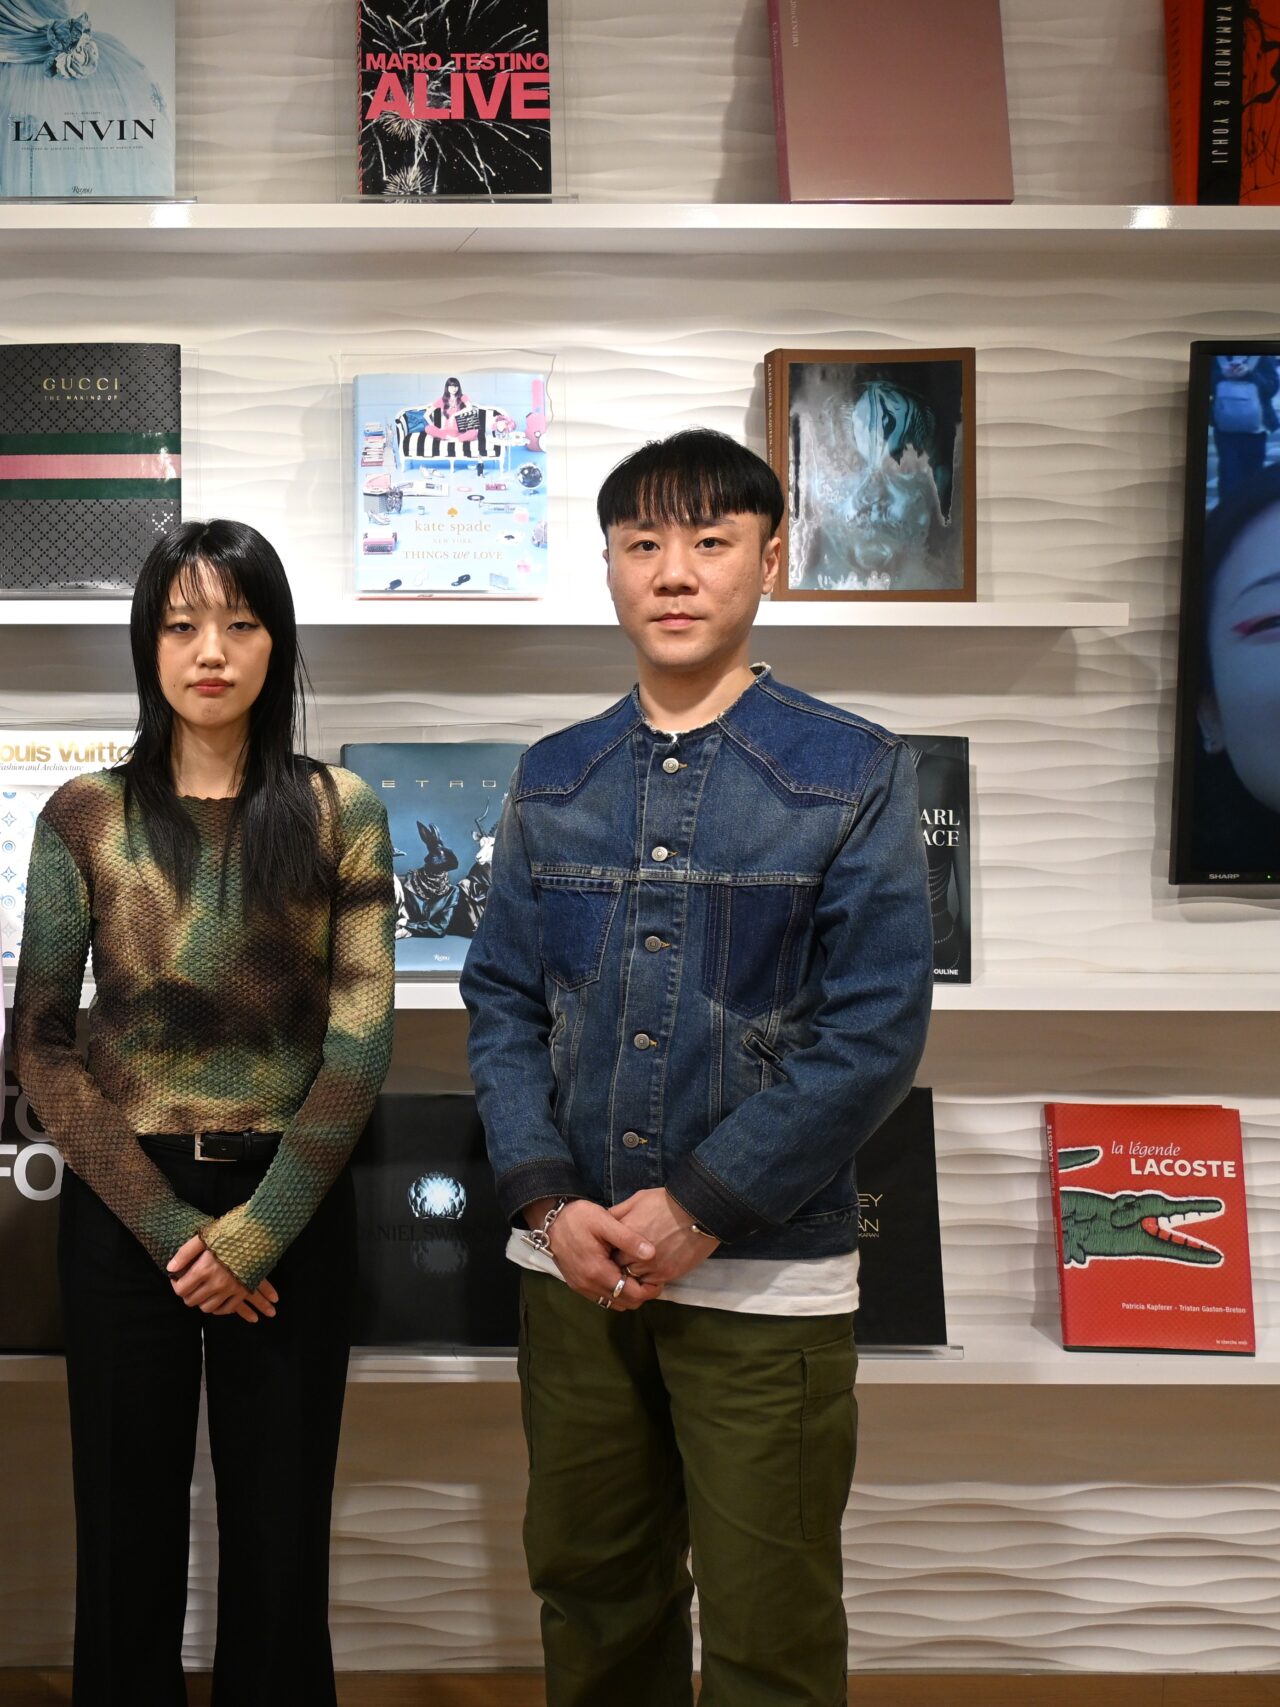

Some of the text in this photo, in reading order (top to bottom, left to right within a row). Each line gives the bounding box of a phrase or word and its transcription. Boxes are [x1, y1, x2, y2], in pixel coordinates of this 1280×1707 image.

[1213, 6, 1233, 87] YAMAMOTO
[365, 52, 550, 71] MARIO TESTINO
[365, 72, 551, 120] ALIVE
[11, 118, 157, 142] LANVIN
[1211, 118, 1230, 164] YOHJI
[42, 377, 118, 391] GUCCI
[414, 520, 492, 537] kate spade
[403, 551, 503, 560] THINGS we LOVE
[25, 763, 40, 771] and
[40, 763, 84, 771] Architecture
[381, 780, 497, 788] ETRO
[920, 808, 960, 826] ARL
[1111, 1140, 1181, 1158] la légende
[1130, 1158, 1237, 1178] LACOSTE
[1121, 1302, 1146, 1311] Patricia
[1146, 1303, 1173, 1312] Kapferer
[1179, 1304, 1200, 1312] Tristan
[1201, 1305, 1247, 1314] Gaston-Breton
